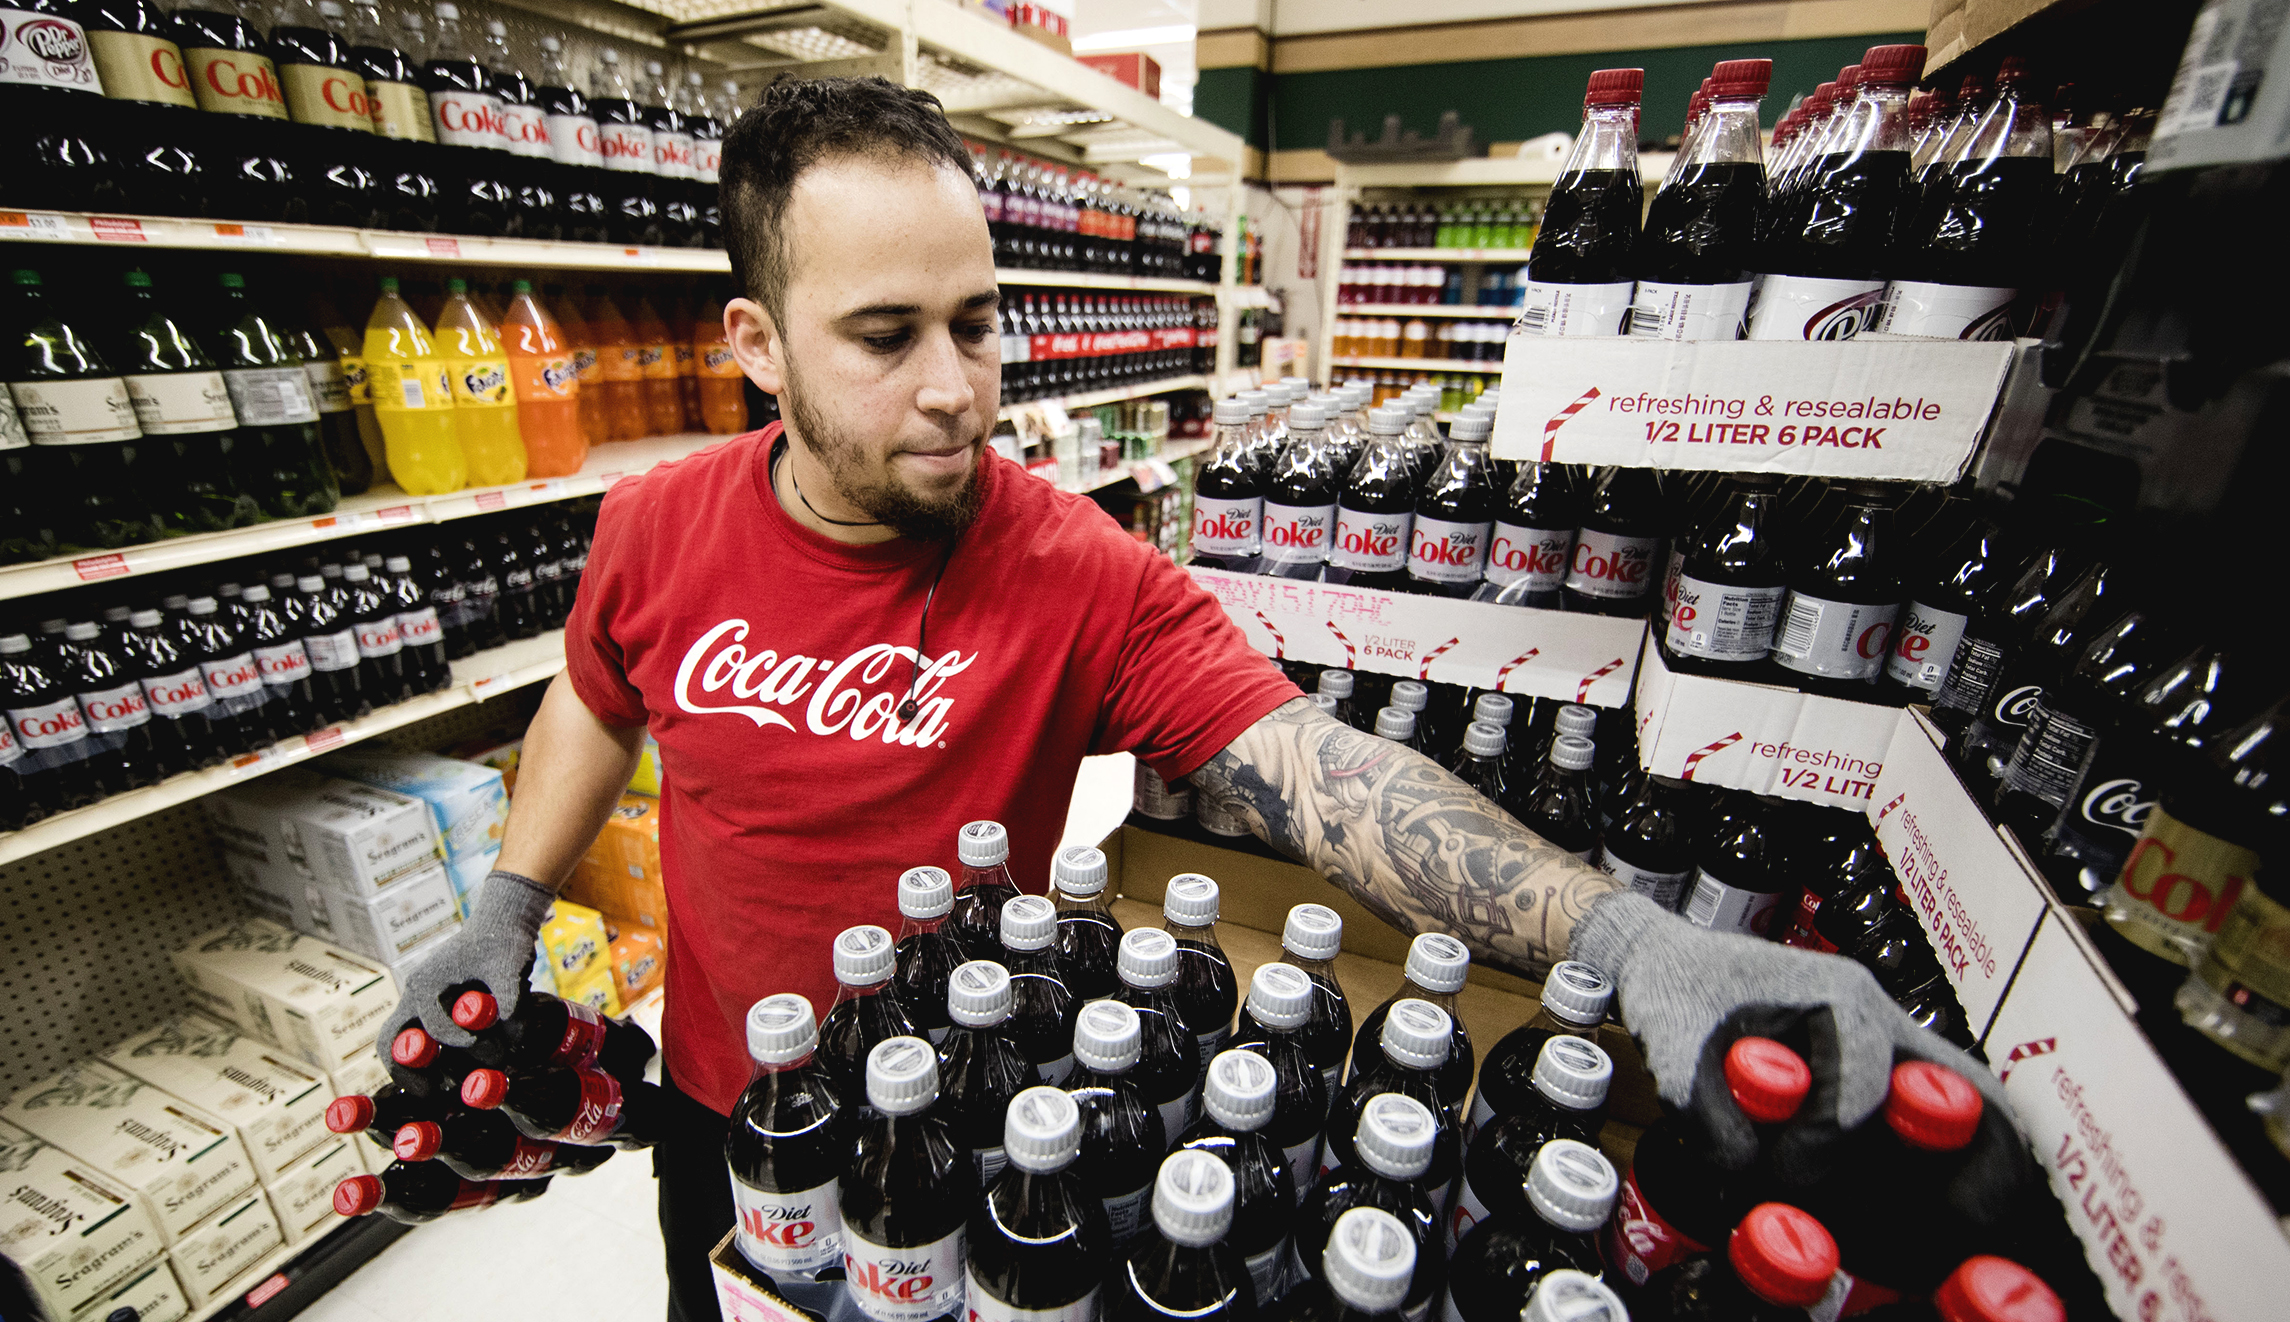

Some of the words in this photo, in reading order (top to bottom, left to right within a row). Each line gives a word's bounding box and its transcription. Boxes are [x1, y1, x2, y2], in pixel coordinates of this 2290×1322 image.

[48, 25, 69, 42] Dr
[1609, 391, 1744, 419] refreshing
[1754, 394, 1775, 416] &
[1784, 395, 1941, 421] resealable
[1644, 420, 1680, 445] 1/2
[1687, 422, 1770, 446] LITER
[1777, 424, 1796, 447] 6
[1801, 426, 1887, 450] PACK
[1194, 508, 1251, 540] Coke
[1227, 508, 1252, 520] Diet
[1299, 516, 1324, 528] Diet
[1373, 523, 1400, 535] Diet
[1263, 515, 1323, 548] Coke
[1335, 521, 1398, 556] Coke
[1450, 532, 1477, 545] Diet
[1411, 529, 1475, 567] Coke
[1491, 537, 1564, 574] Coke
[1572, 543, 1648, 583] Coke
[1678, 585, 1700, 606] Diet
[1906, 612, 1936, 635] Diet
[1363, 644, 1372, 655] 6
[1376, 647, 1414, 661] PACK
[1364, 634, 1380, 645] 1/2
[1383, 637, 1416, 650] LITER
[673, 618, 979, 749] Coca-Cola
[1750, 741, 1884, 780] refreshing
[1782, 767, 1820, 789] 1/2
[1899, 808, 1939, 882] refreshing
[1935, 868, 1949, 894] &
[1943, 886, 1996, 979] resealable
[1899, 846, 1916, 879] 1/2
[1910, 868, 1937, 921] LITER
[1931, 910, 1944, 932] 6
[1938, 922, 1970, 983] PACK
[331, 1000, 393, 1040] Seagram's
[2051, 1065, 2146, 1225] refreshing
[165, 1161, 239, 1213] Seagram's
[762, 1204, 811, 1221] Diet
[2056, 1132, 2088, 1192] 1/2
[2081, 1182, 2145, 1294] LITER
[56, 1230, 144, 1291] Seagram's
[197, 1223, 270, 1274] Seagram's
[879, 1258, 932, 1276] Diet
